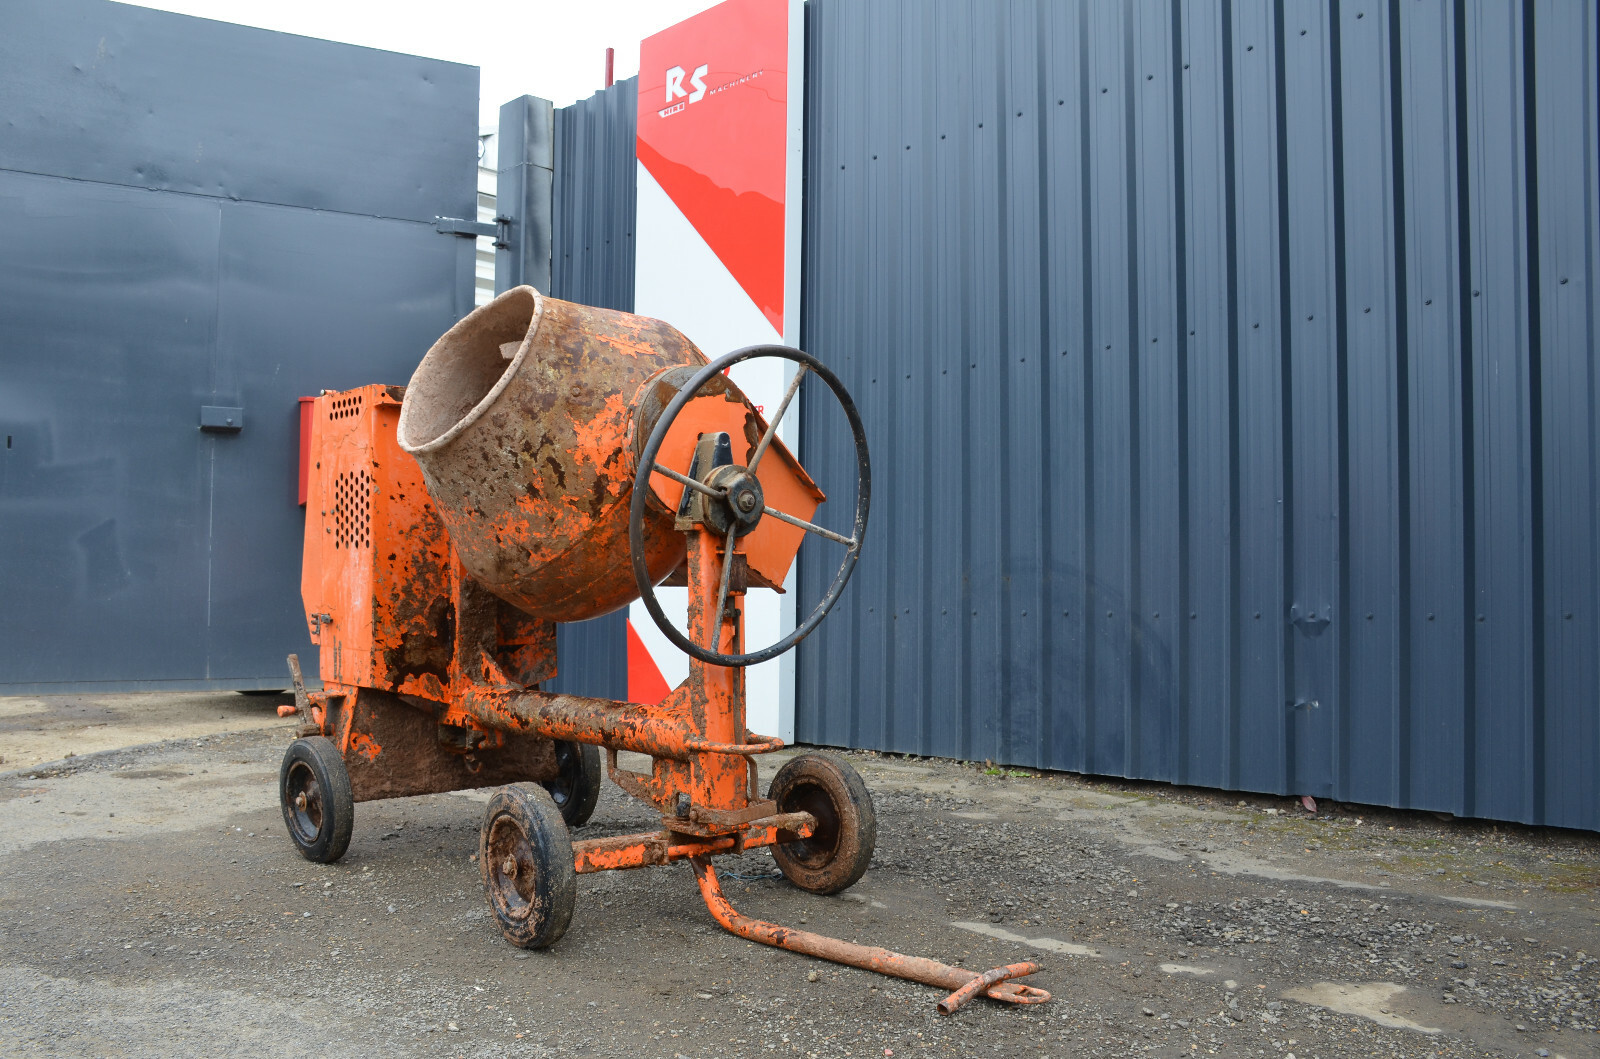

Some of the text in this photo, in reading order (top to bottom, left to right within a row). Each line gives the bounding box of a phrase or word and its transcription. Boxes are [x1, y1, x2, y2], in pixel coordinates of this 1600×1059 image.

[665, 63, 764, 104] RS MACHINERY
[663, 103, 684, 116] HIRE
